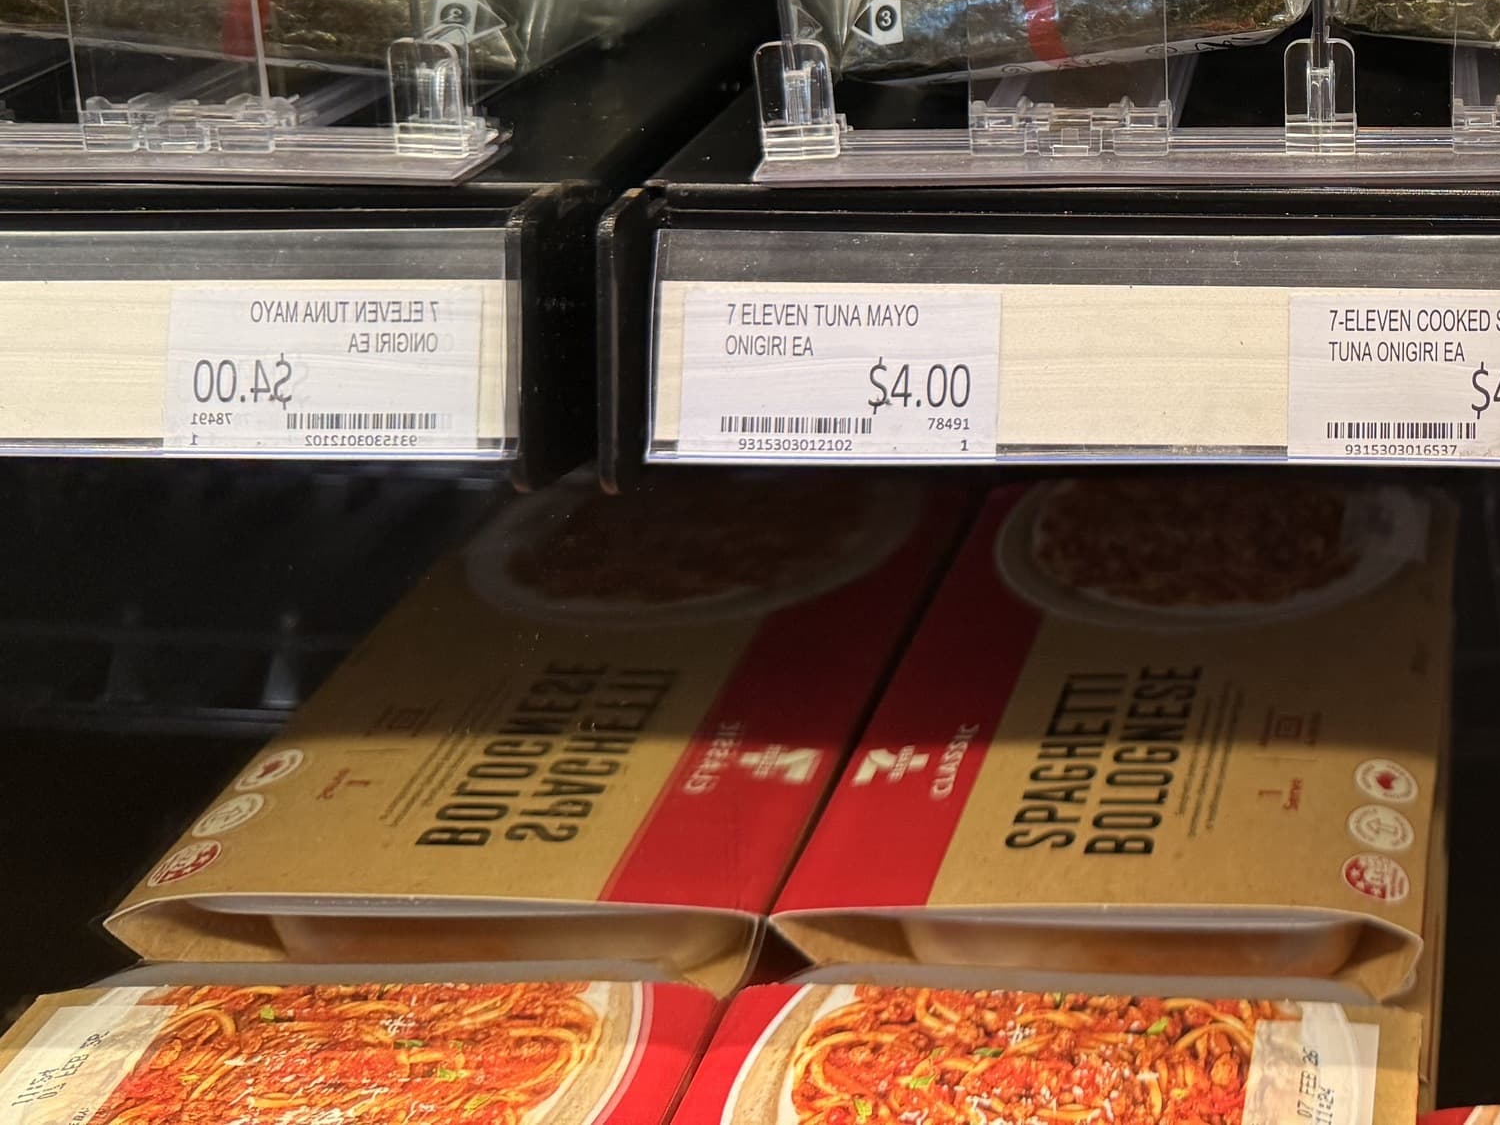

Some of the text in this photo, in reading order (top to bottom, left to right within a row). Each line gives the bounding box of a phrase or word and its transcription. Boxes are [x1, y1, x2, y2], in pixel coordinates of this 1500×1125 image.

[727, 303, 919, 327] 7 ELEVEN TUNA MAYO
[1329, 309, 1411, 332] 7-ELEVEN
[1417, 309, 1491, 332] COOKED
[725, 335, 814, 356] ONIGIRI EA
[1328, 341, 1465, 362] TUNA ONIGIRI EA
[868, 356, 971, 415] $4.00
[927, 417, 970, 430] 78491
[738, 439, 853, 452] 9315303012102
[960, 439, 969, 451] 1
[1345, 444, 1458, 456] 9315303016537
[929, 723, 981, 801] CLASSIC
[1005, 672, 1129, 849] SPAGHETTI
[1084, 666, 1203, 854] BOLOGNESE
